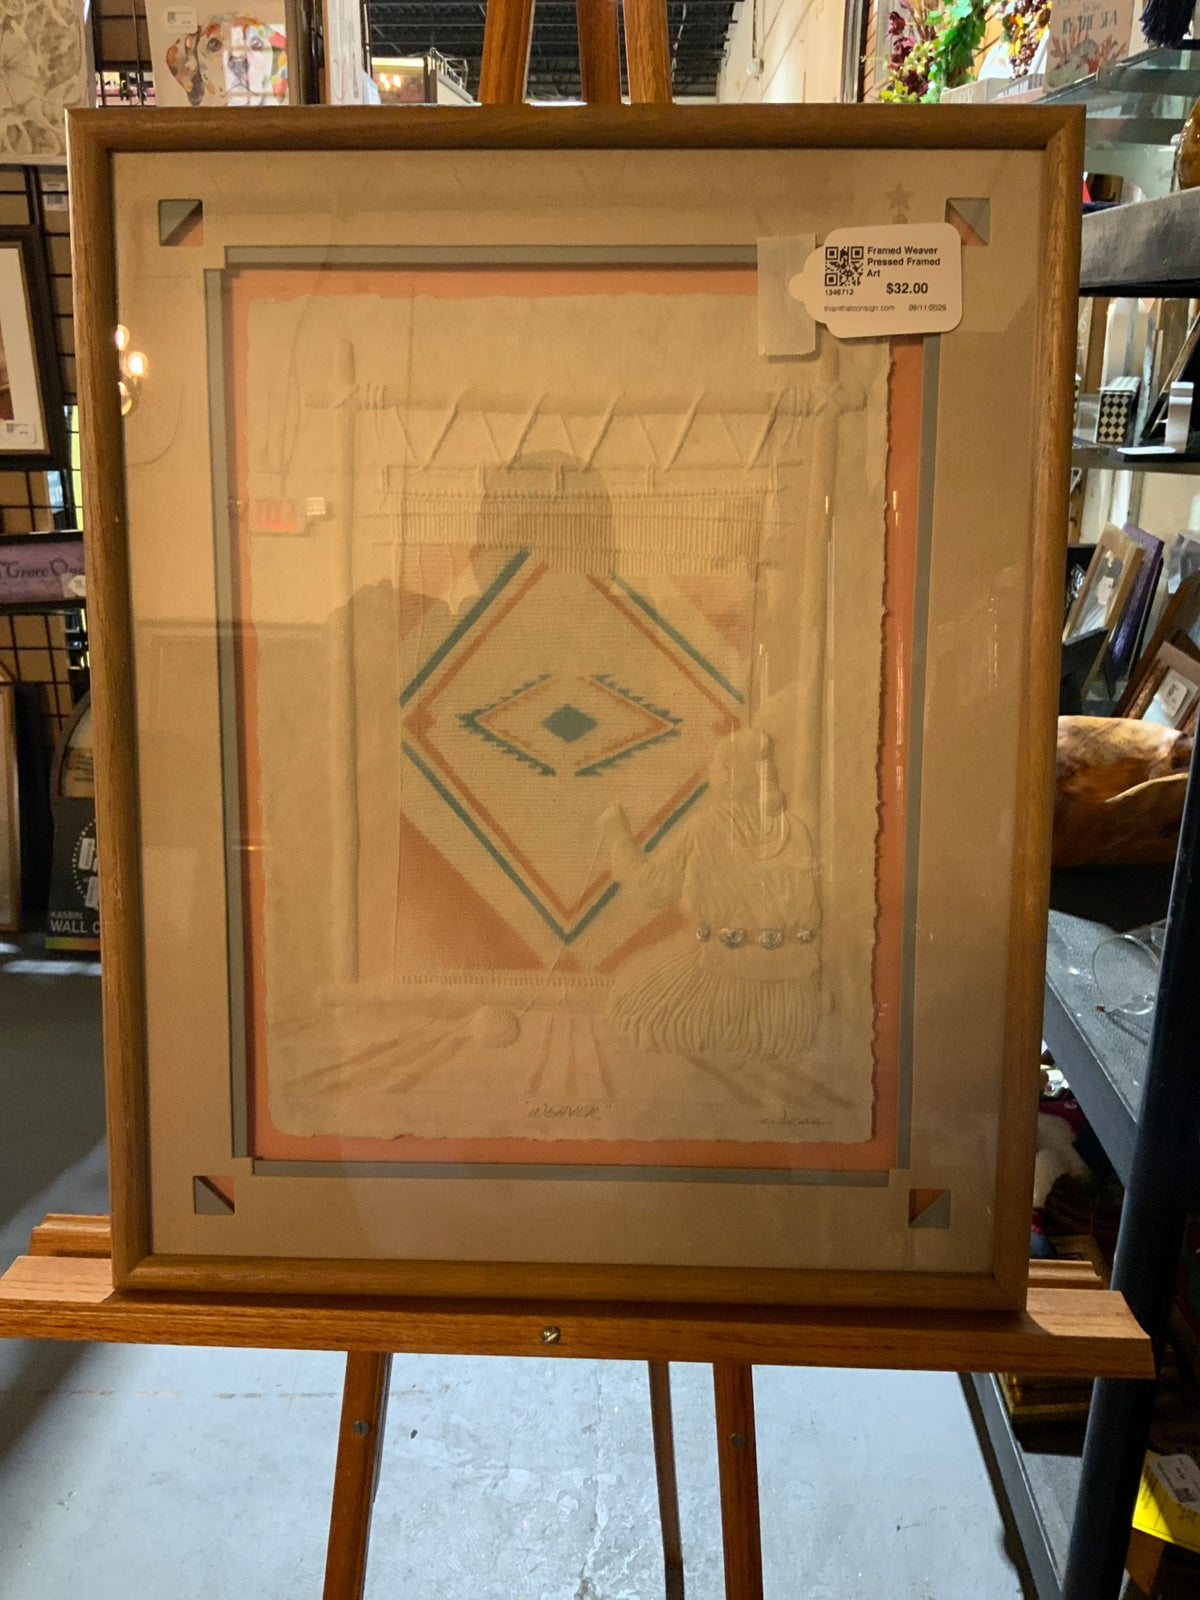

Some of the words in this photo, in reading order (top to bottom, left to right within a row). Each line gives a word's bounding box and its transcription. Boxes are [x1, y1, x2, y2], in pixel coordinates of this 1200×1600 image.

[867, 246, 902, 255] Framed
[903, 246, 938, 255] Weaver
[867, 257, 904, 266] Pressed
[906, 257, 941, 266] Framed
[866, 269, 881, 278] Art
[886, 282, 929, 295] $32.00
[51, 920, 88, 933] WALL
